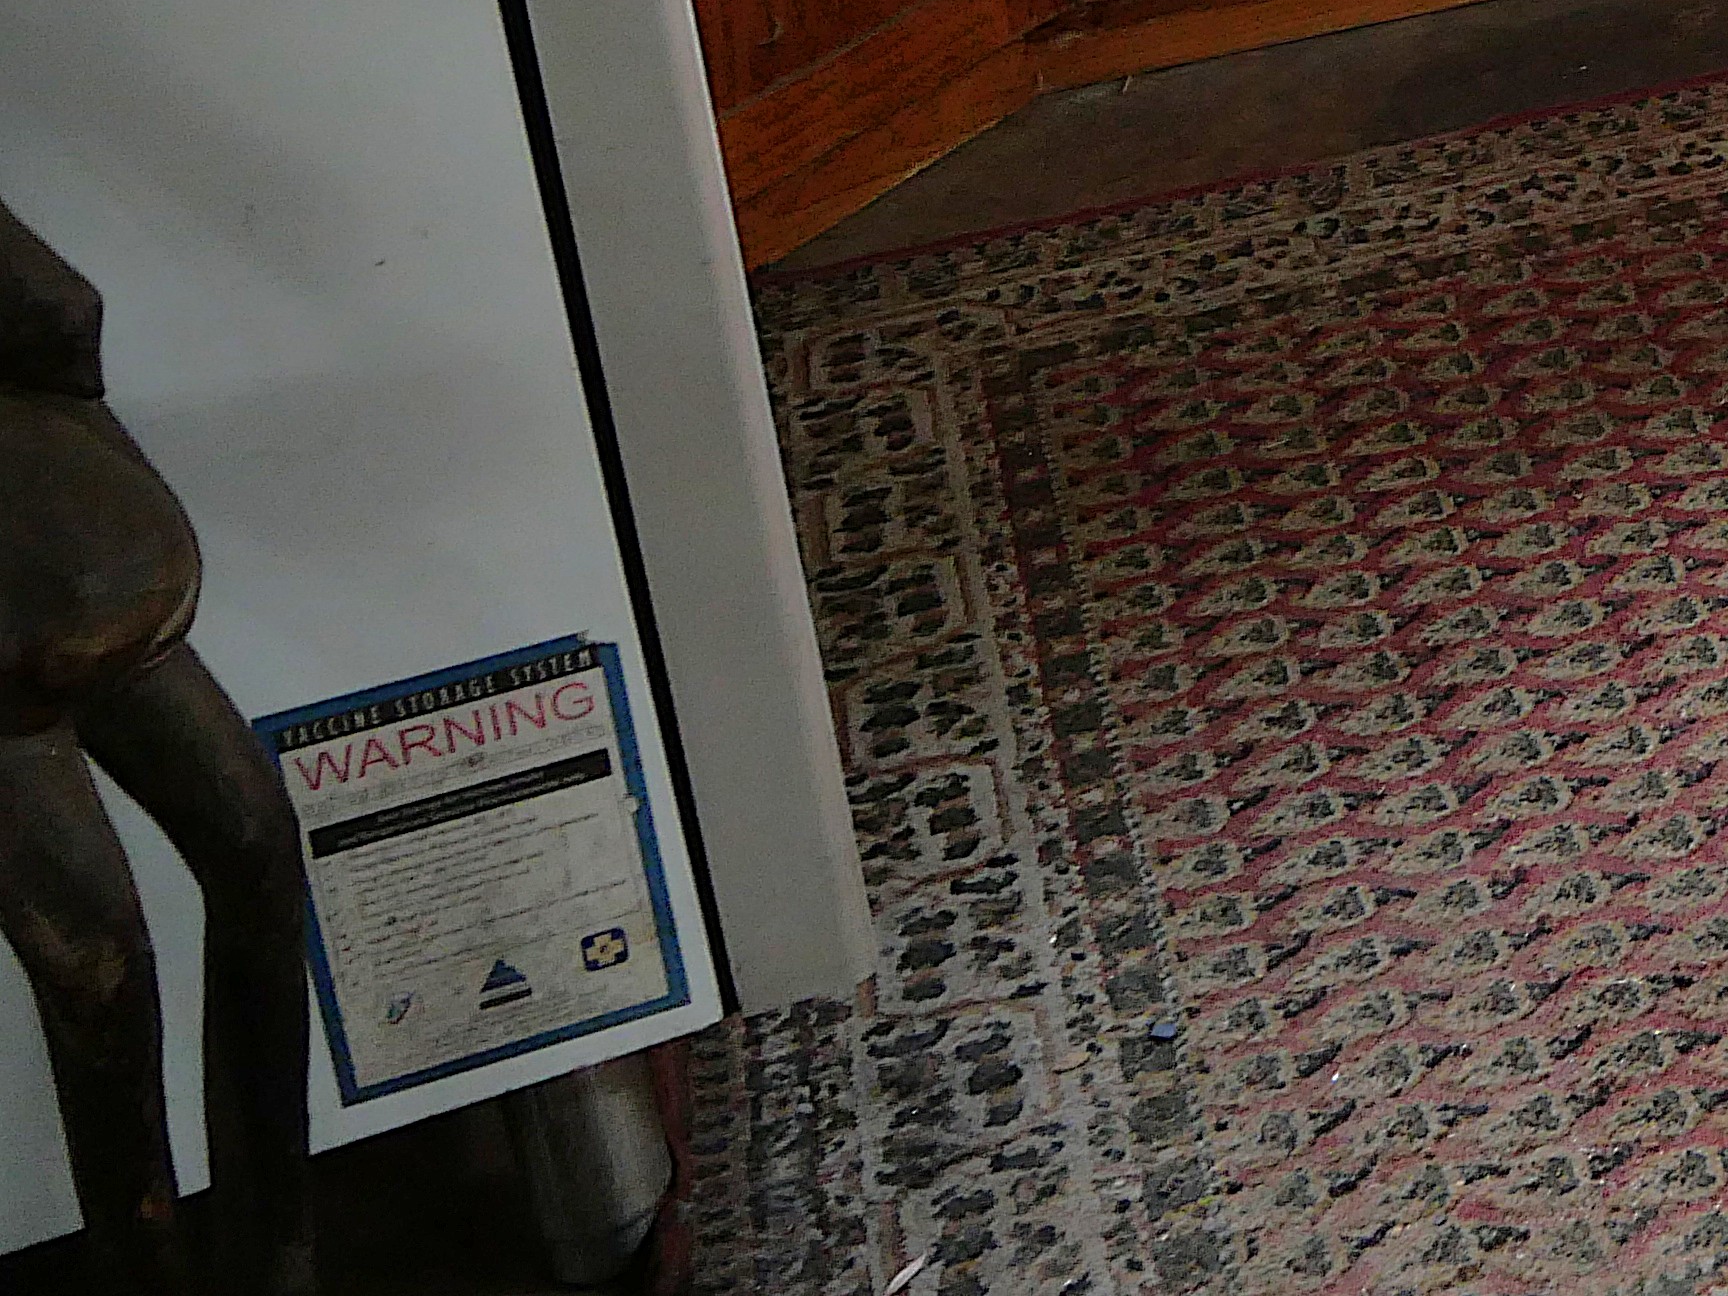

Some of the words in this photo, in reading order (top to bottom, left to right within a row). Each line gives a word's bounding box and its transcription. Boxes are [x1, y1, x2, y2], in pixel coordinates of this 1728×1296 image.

[395, 676, 496, 715] STORAGE
[509, 649, 593, 686] SYSTEM
[294, 682, 595, 791] WARNING
